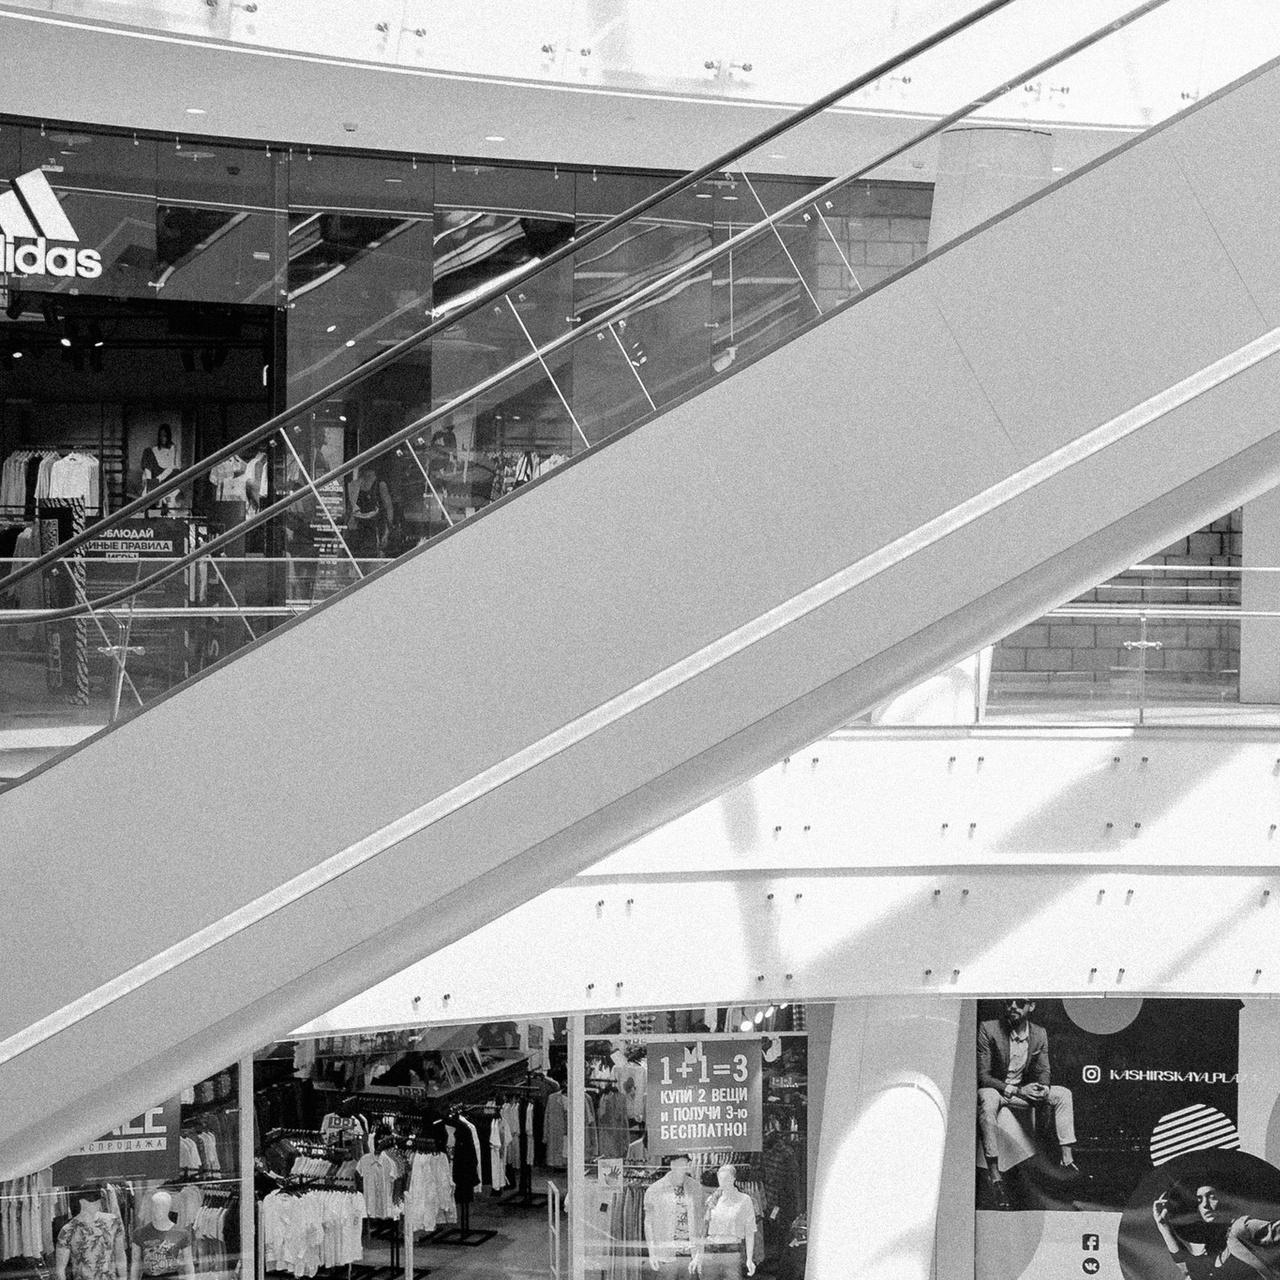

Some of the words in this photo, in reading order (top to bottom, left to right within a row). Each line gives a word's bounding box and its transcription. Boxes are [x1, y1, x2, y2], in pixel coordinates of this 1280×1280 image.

[121, 541, 170, 551] ПРАВИЛА
[660, 1088, 693, 1105] КУПИ
[698, 1088, 707, 1103] 2
[711, 1086, 748, 1104] ВЕЩИ
[673, 1105, 721, 1122] ПОЛУЧИ
[725, 1105, 748, 1120] 3-ю
[660, 1122, 748, 1141] БЕСПЛАТНО!
